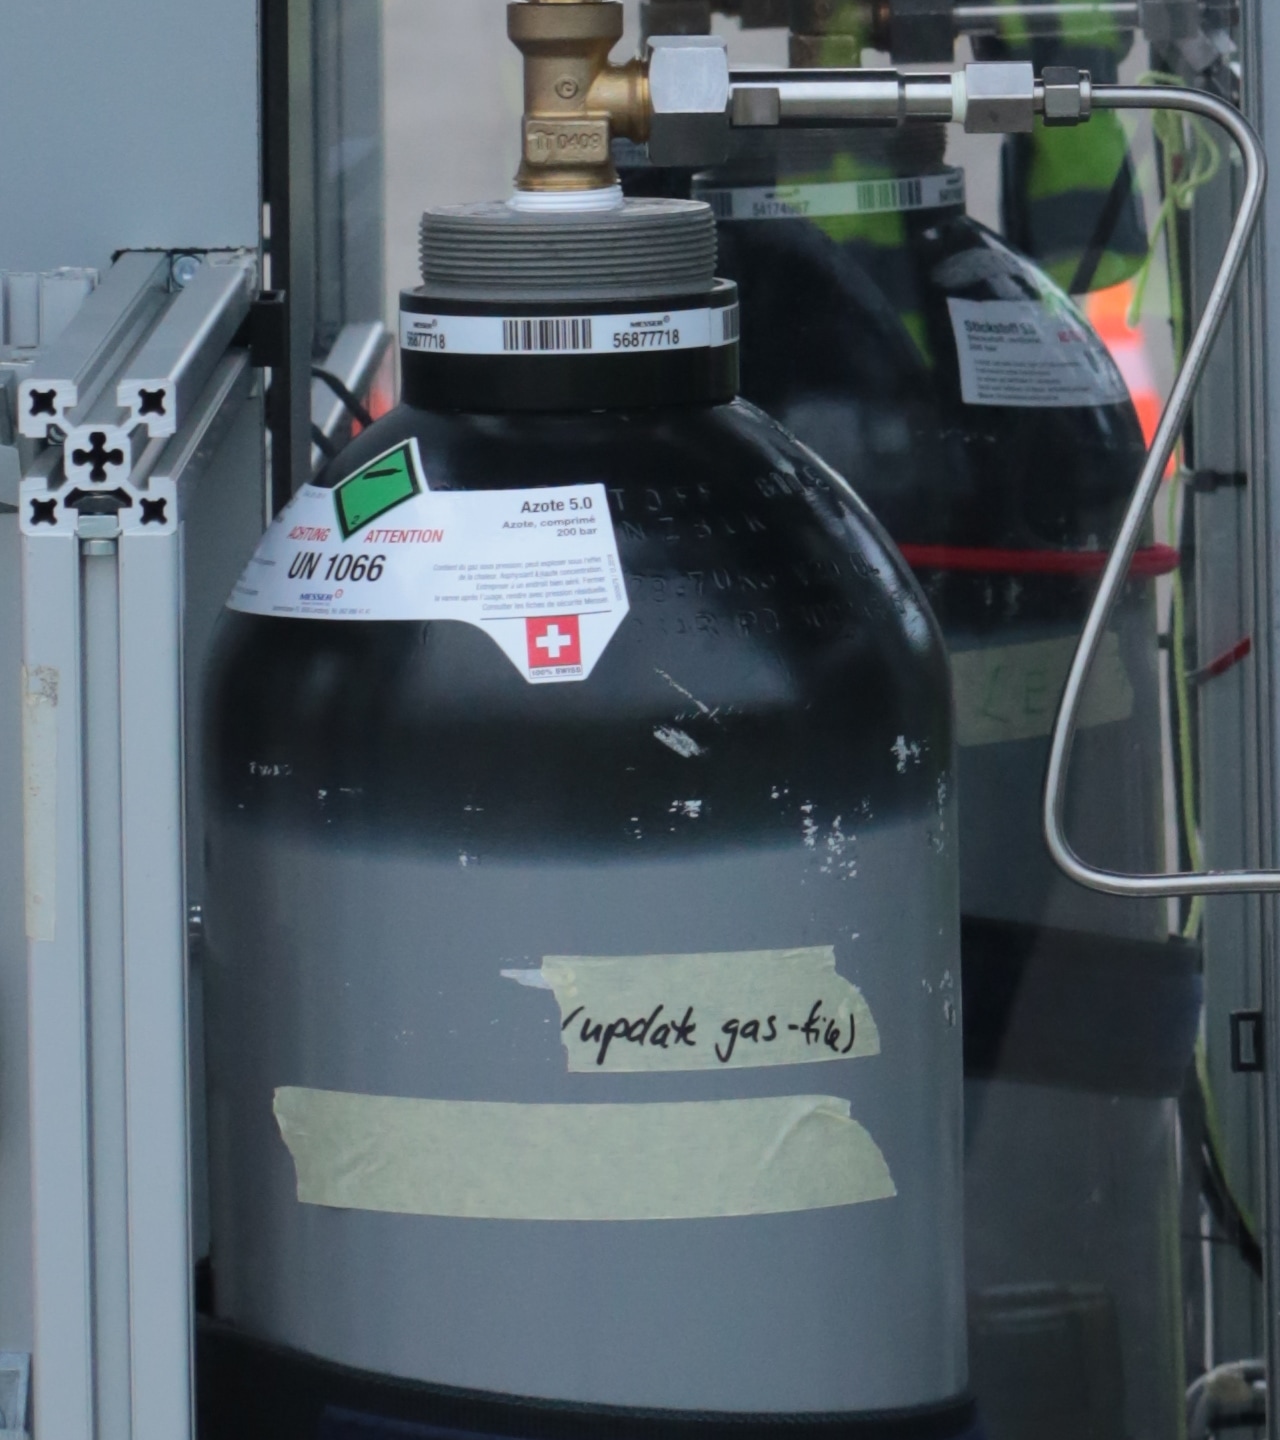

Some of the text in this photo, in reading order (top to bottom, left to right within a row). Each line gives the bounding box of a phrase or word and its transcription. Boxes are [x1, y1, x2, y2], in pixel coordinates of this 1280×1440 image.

[613, 329, 679, 349] 56877718
[521, 500, 564, 514] Azote
[569, 497, 592, 510] 5.0
[502, 515, 596, 529] Azote, comprimé
[363, 529, 444, 543] ATTENTION
[557, 527, 597, 537] 200 bar
[288, 551, 386, 582] UN 1066
[300, 592, 333, 601] MESSER
